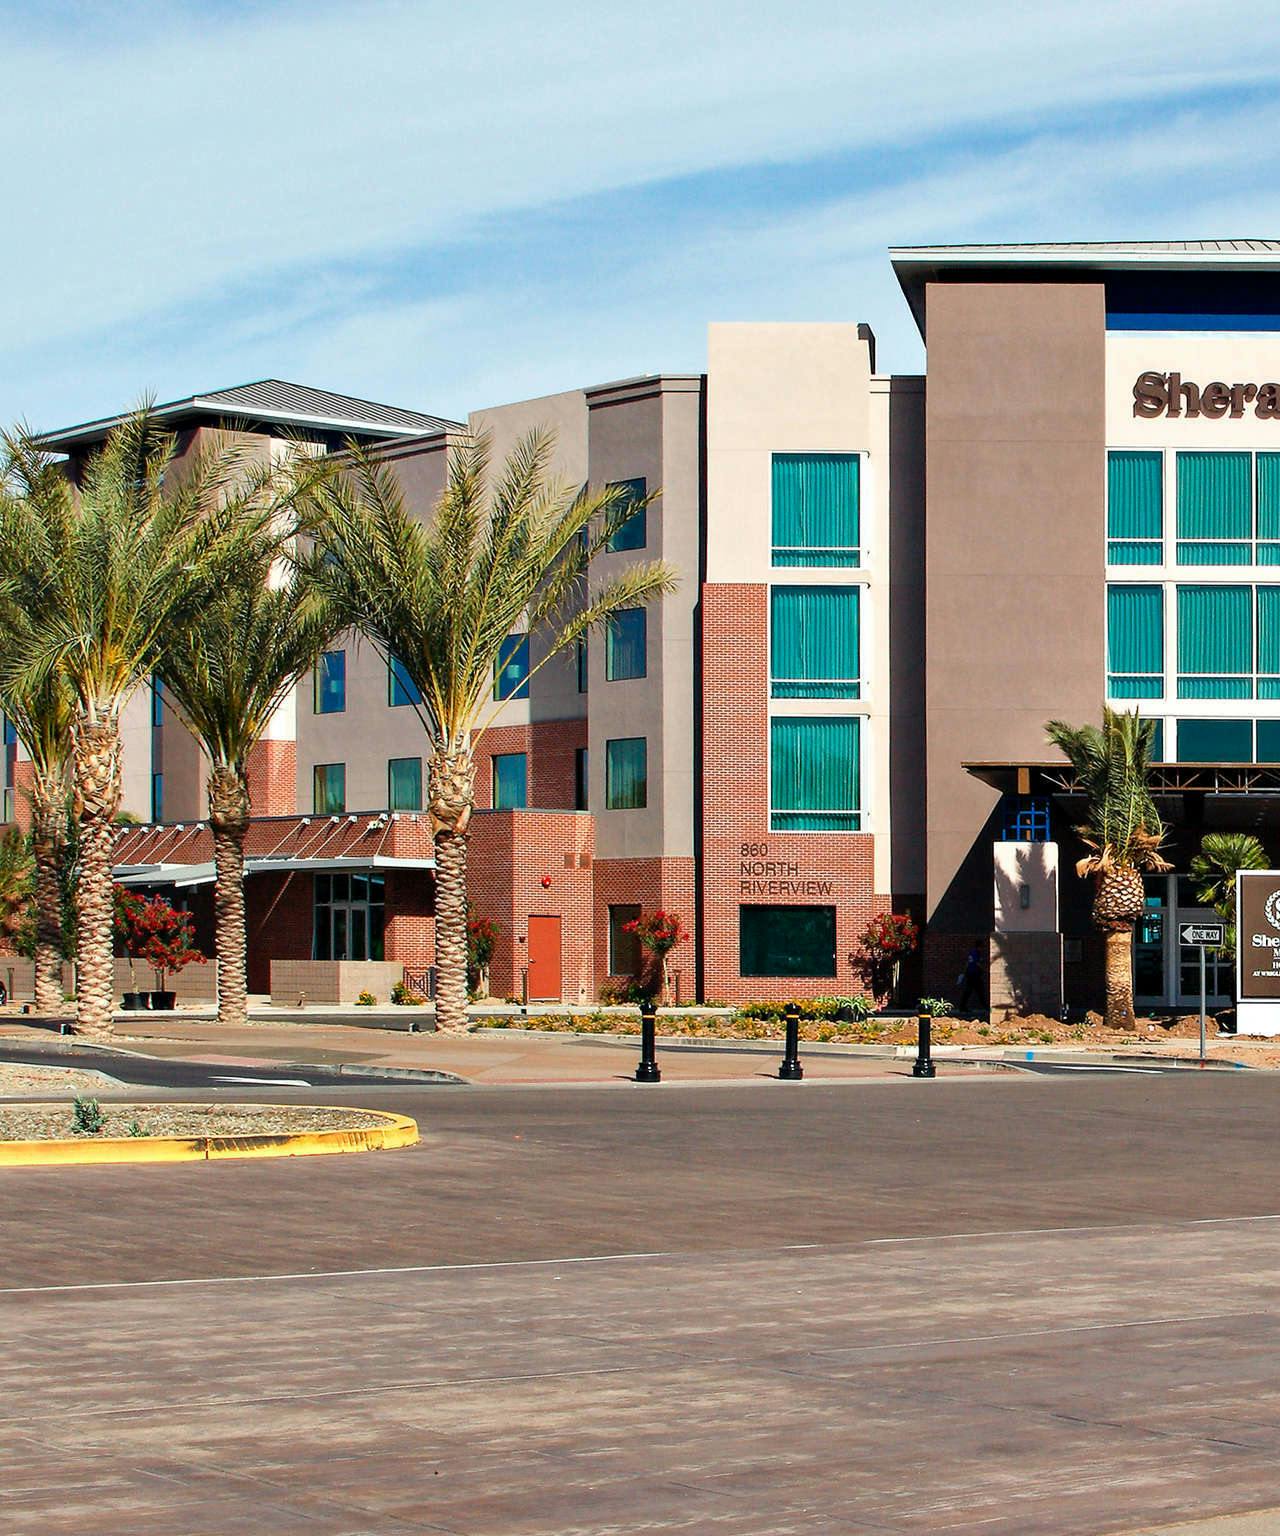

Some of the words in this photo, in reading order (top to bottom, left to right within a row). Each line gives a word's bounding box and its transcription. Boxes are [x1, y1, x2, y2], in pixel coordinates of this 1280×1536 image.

[740, 843, 768, 857] 860
[740, 861, 799, 877] NORTH
[740, 881, 833, 895] RIVERVIEW
[1192, 930, 1204, 939] ONE
[1205, 930, 1218, 939] WAY
